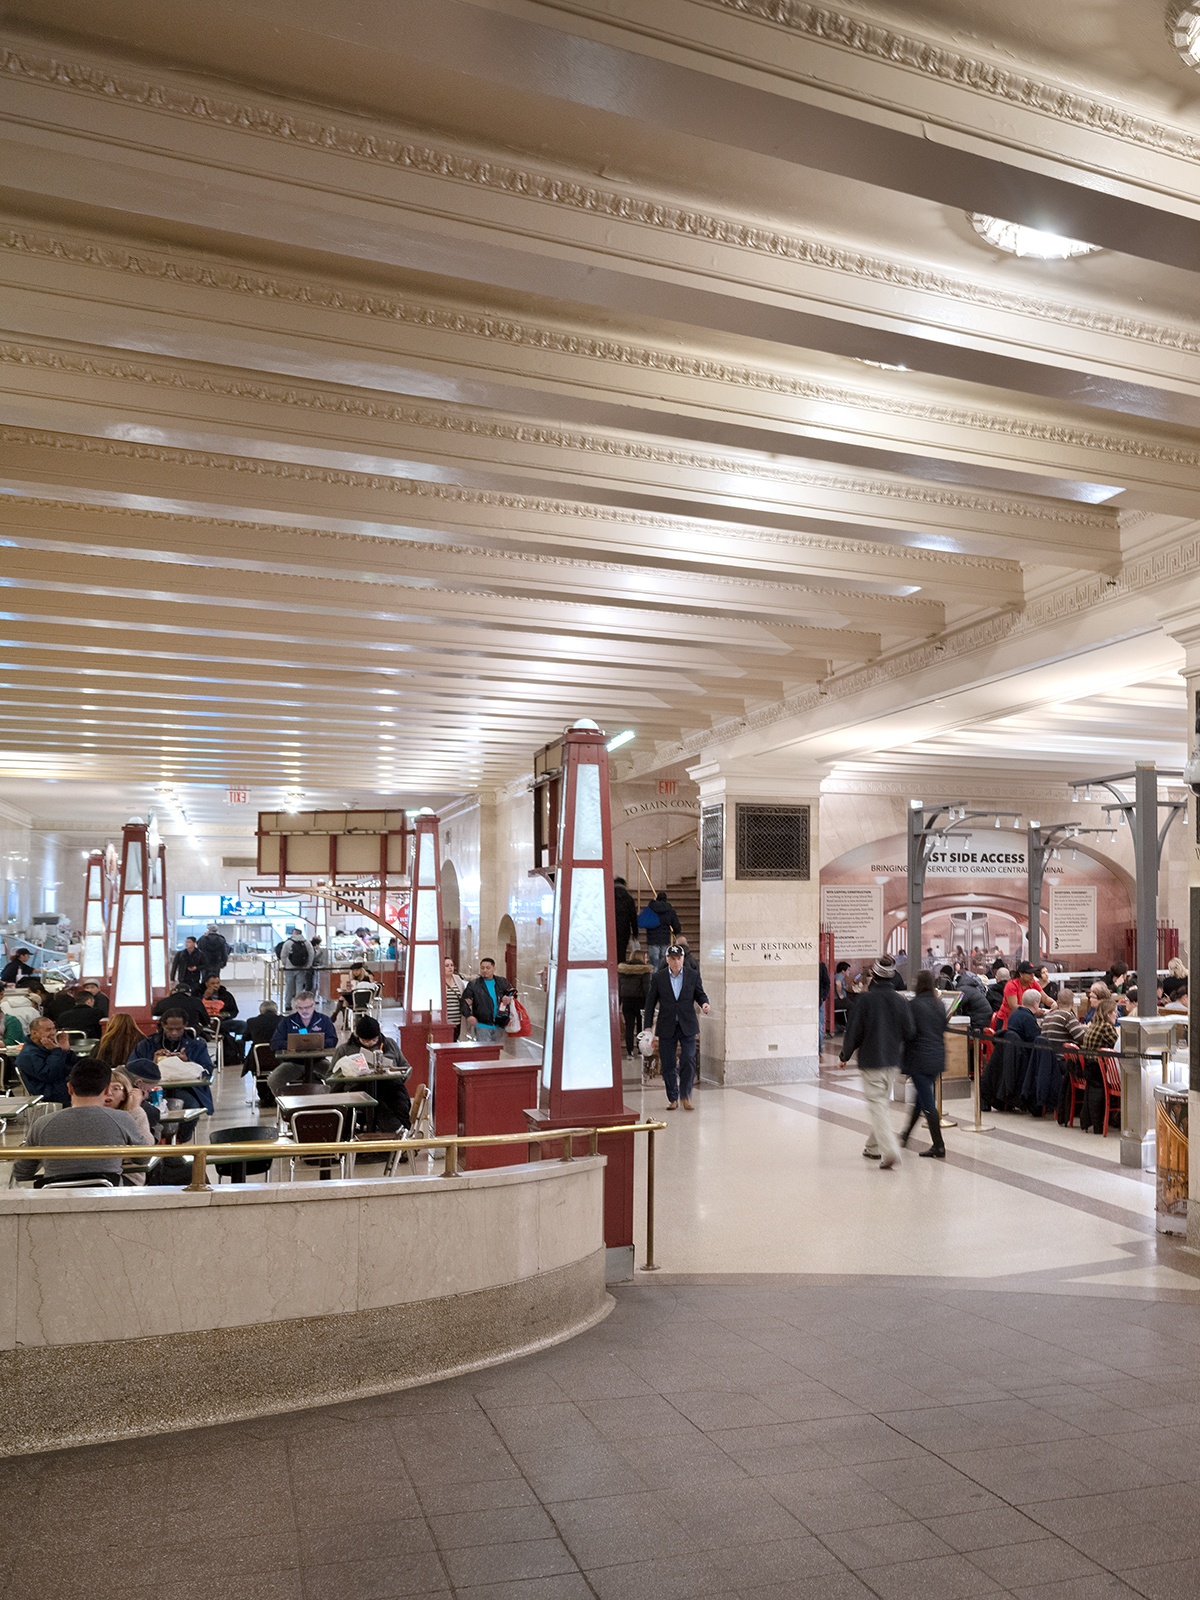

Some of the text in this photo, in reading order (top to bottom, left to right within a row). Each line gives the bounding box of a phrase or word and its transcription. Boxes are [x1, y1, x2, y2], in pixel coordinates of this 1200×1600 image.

[659, 781, 677, 794] EXIT
[623, 800, 701, 816] TO MAIN CONC
[950, 853, 977, 863] SIDE
[980, 853, 1025, 863] ACCESS
[871, 864, 908, 872] BRINGING
[927, 865, 957, 873] SERVICE
[970, 865, 996, 873] GRAND
[998, 866, 1028, 874] CENTRAL
[760, 942, 813, 950] RESTROOMS
